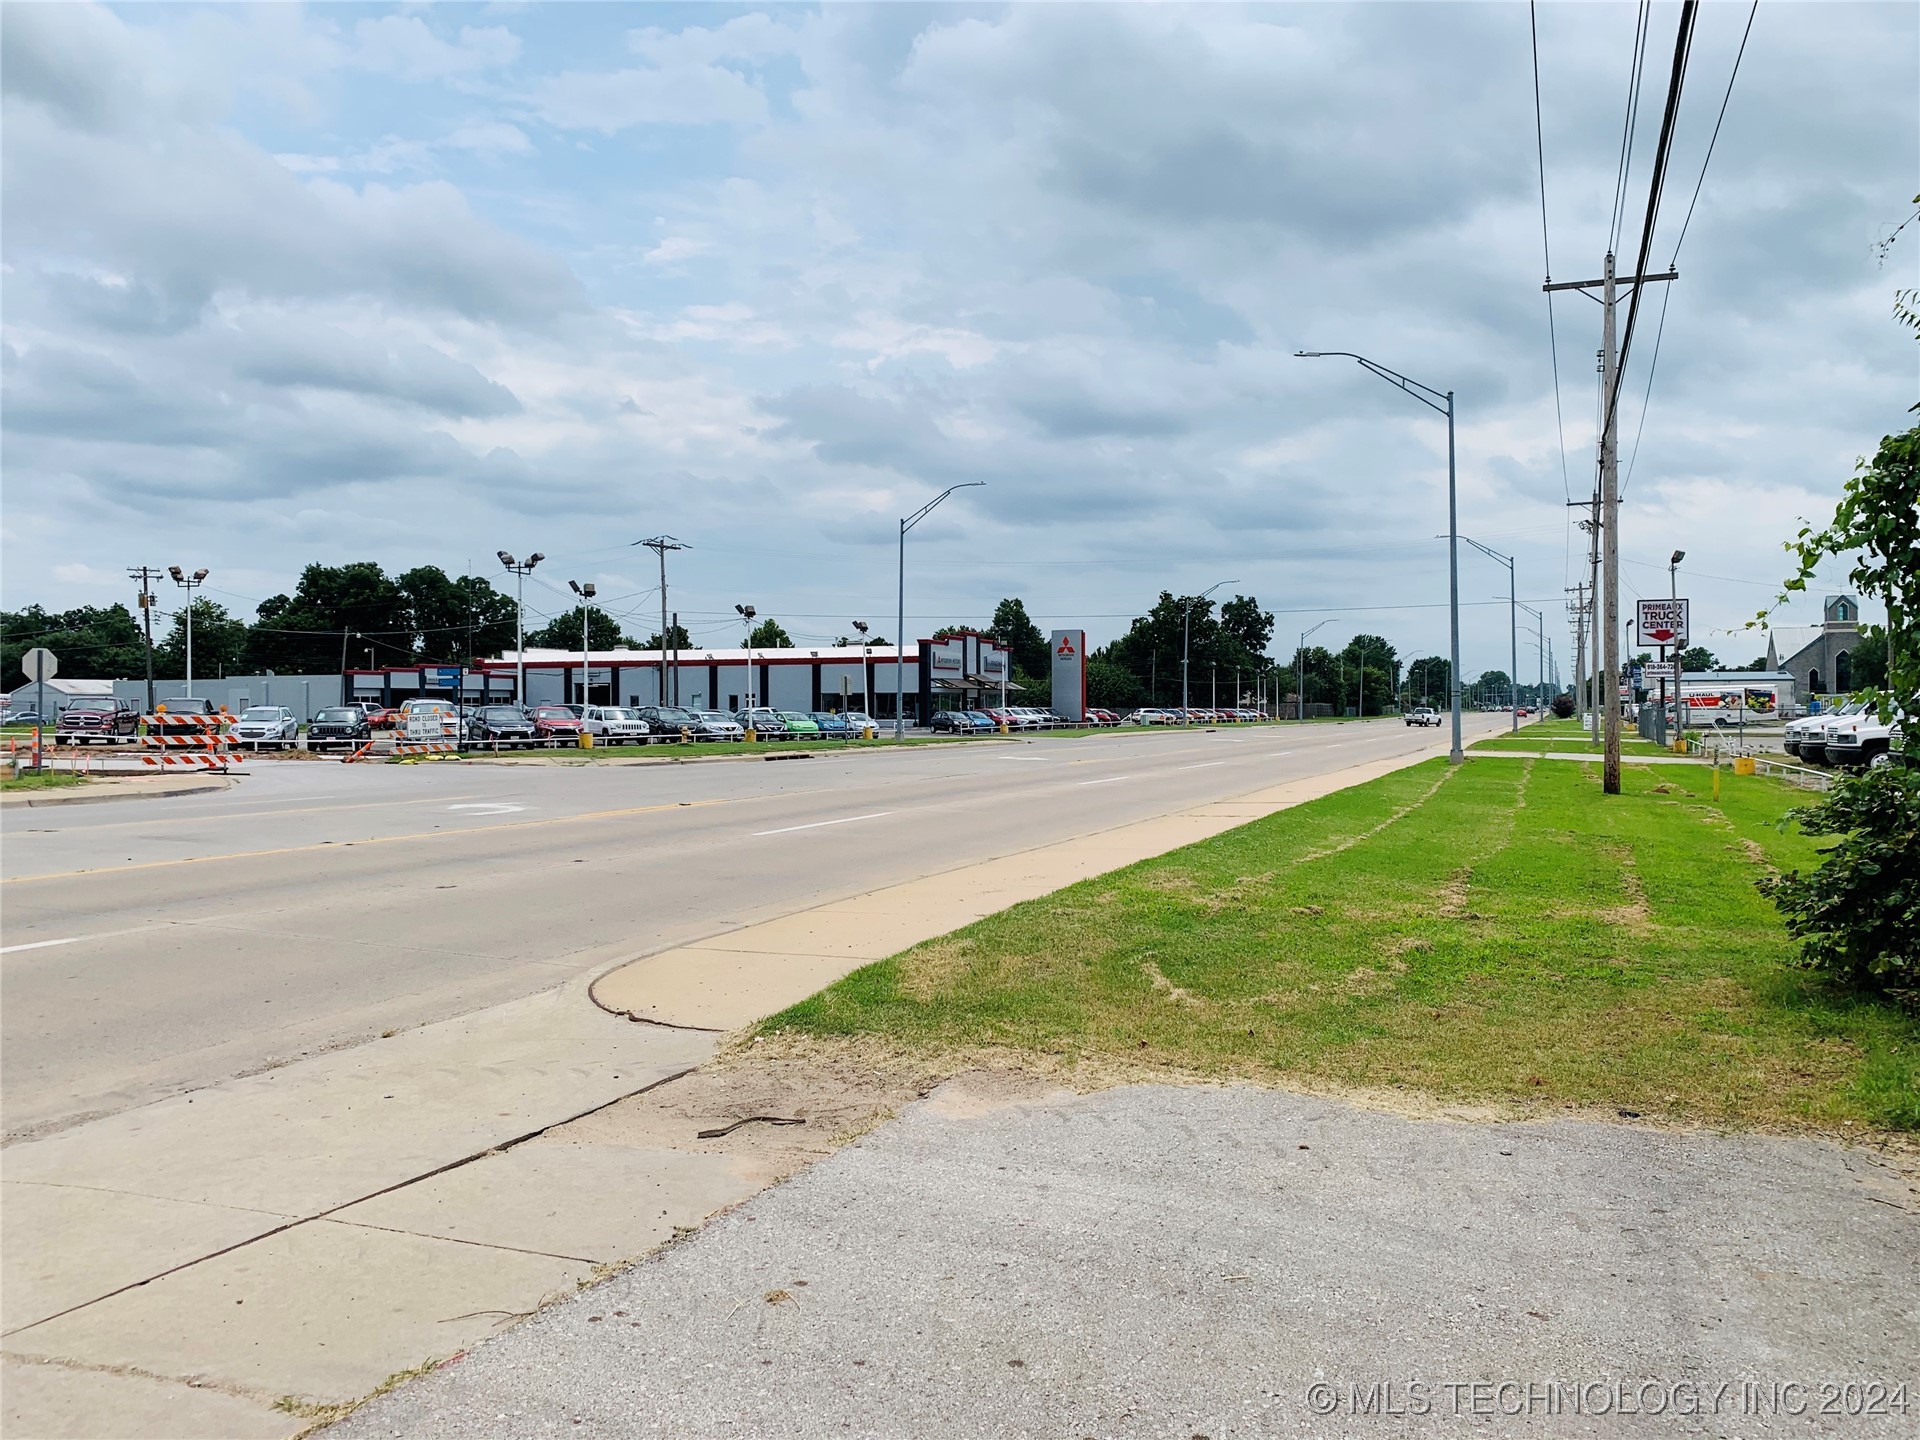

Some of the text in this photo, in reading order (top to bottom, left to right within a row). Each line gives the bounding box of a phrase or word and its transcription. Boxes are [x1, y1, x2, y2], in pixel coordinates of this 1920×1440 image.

[1642, 603, 1683, 611] PRIMEAX
[1643, 611, 1683, 621] TRUCK
[1642, 621, 1684, 629] CENTER
